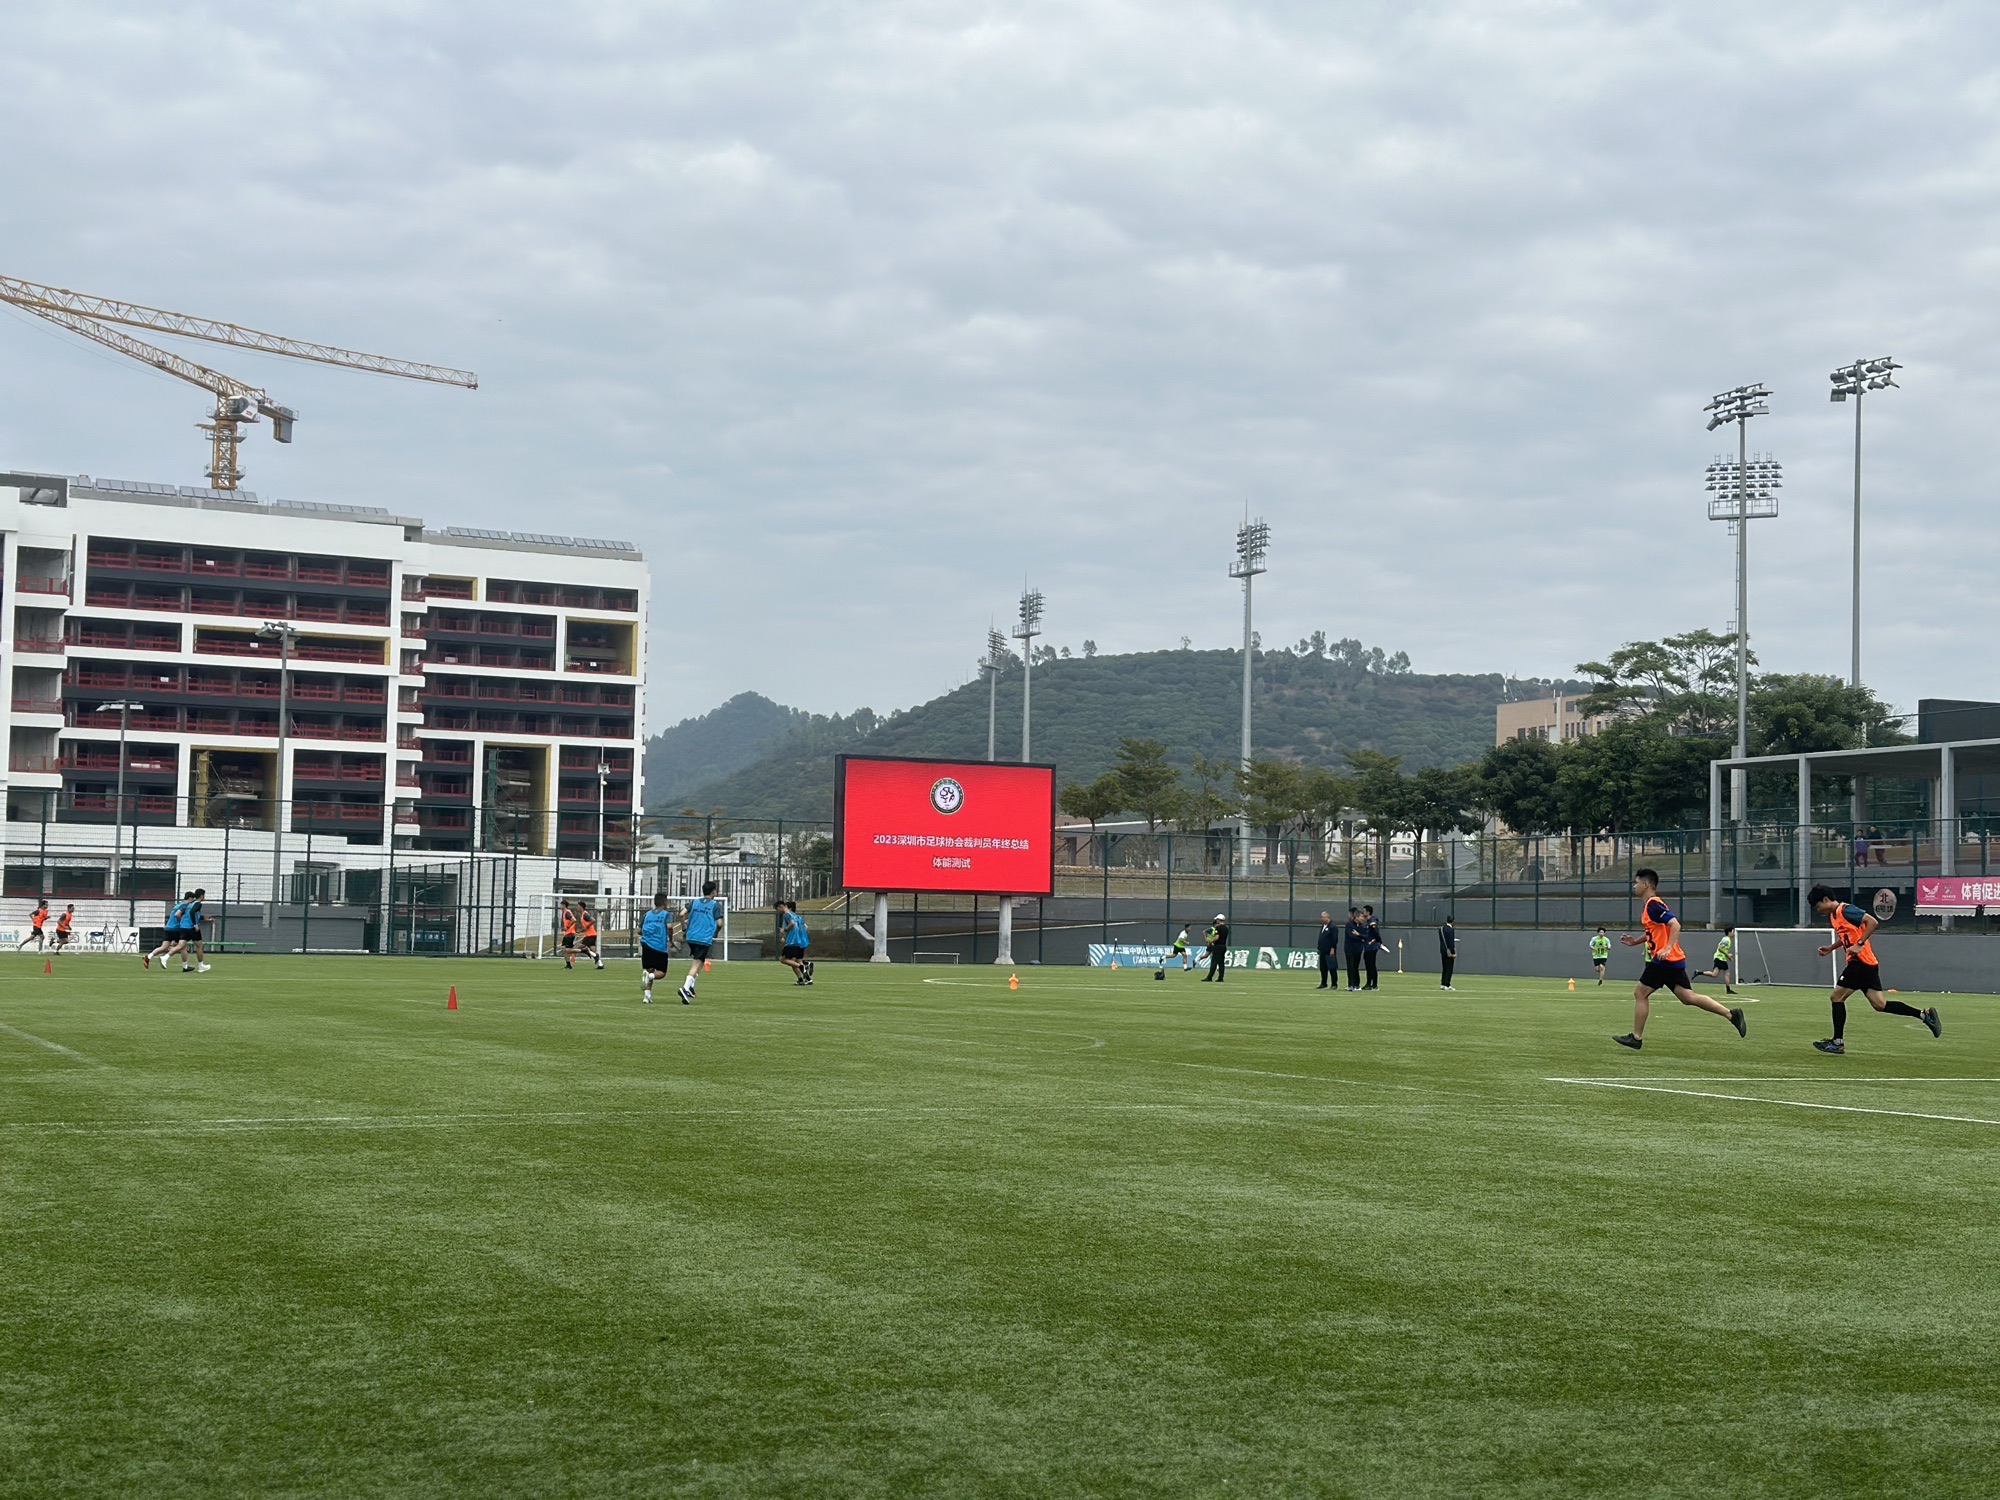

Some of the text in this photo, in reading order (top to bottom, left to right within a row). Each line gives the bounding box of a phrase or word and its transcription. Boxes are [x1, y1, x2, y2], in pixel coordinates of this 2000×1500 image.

[873, 834, 1029, 850] 2023深圳市足球协会裁判员年终总结
[932, 857, 971, 869] 体能测试
[1880, 892, 1889, 904] 北
[1287, 950, 1320, 969] 怡寶
